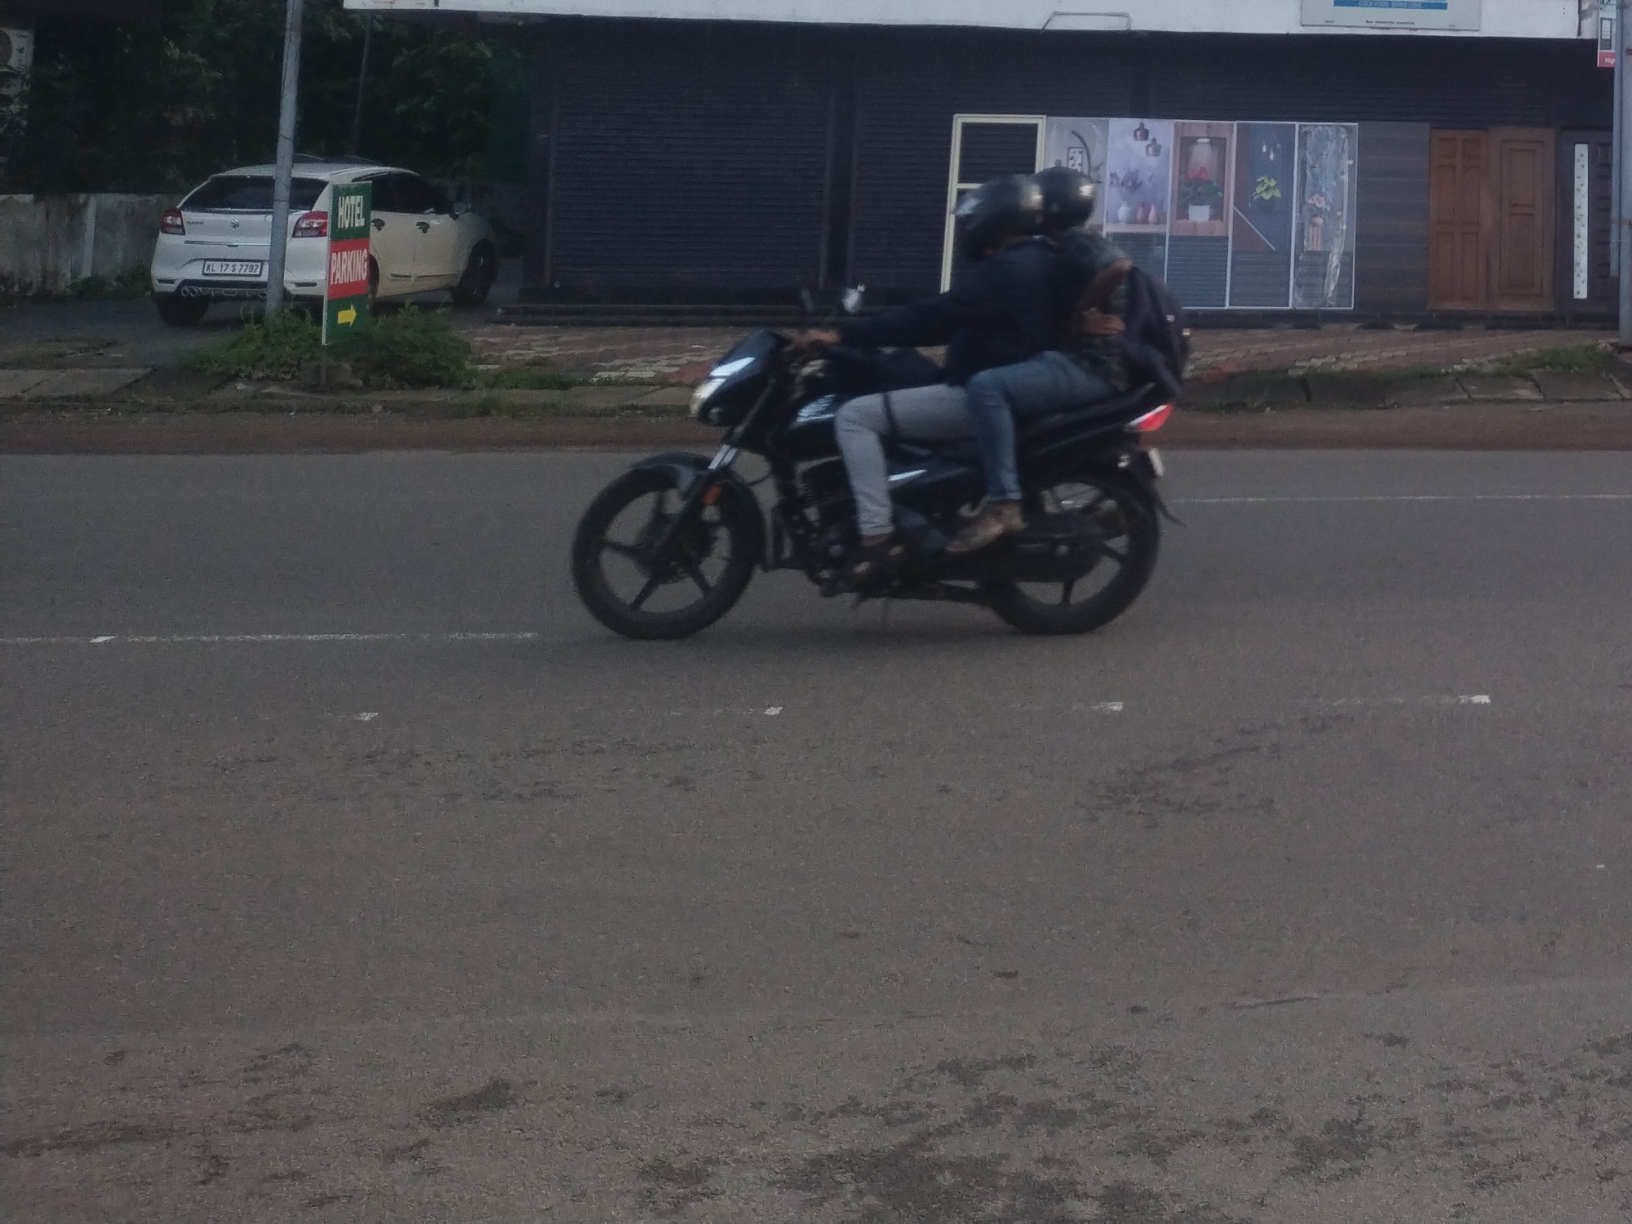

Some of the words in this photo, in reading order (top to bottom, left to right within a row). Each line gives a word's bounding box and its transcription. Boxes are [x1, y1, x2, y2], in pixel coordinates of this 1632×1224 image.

[337, 195, 366, 229] HOTEL
[205, 263, 216, 273] KL
[219, 263, 230, 273] 17
[231, 264, 237, 273] S
[238, 264, 260, 274] 7797
[329, 248, 368, 286] PARKING
